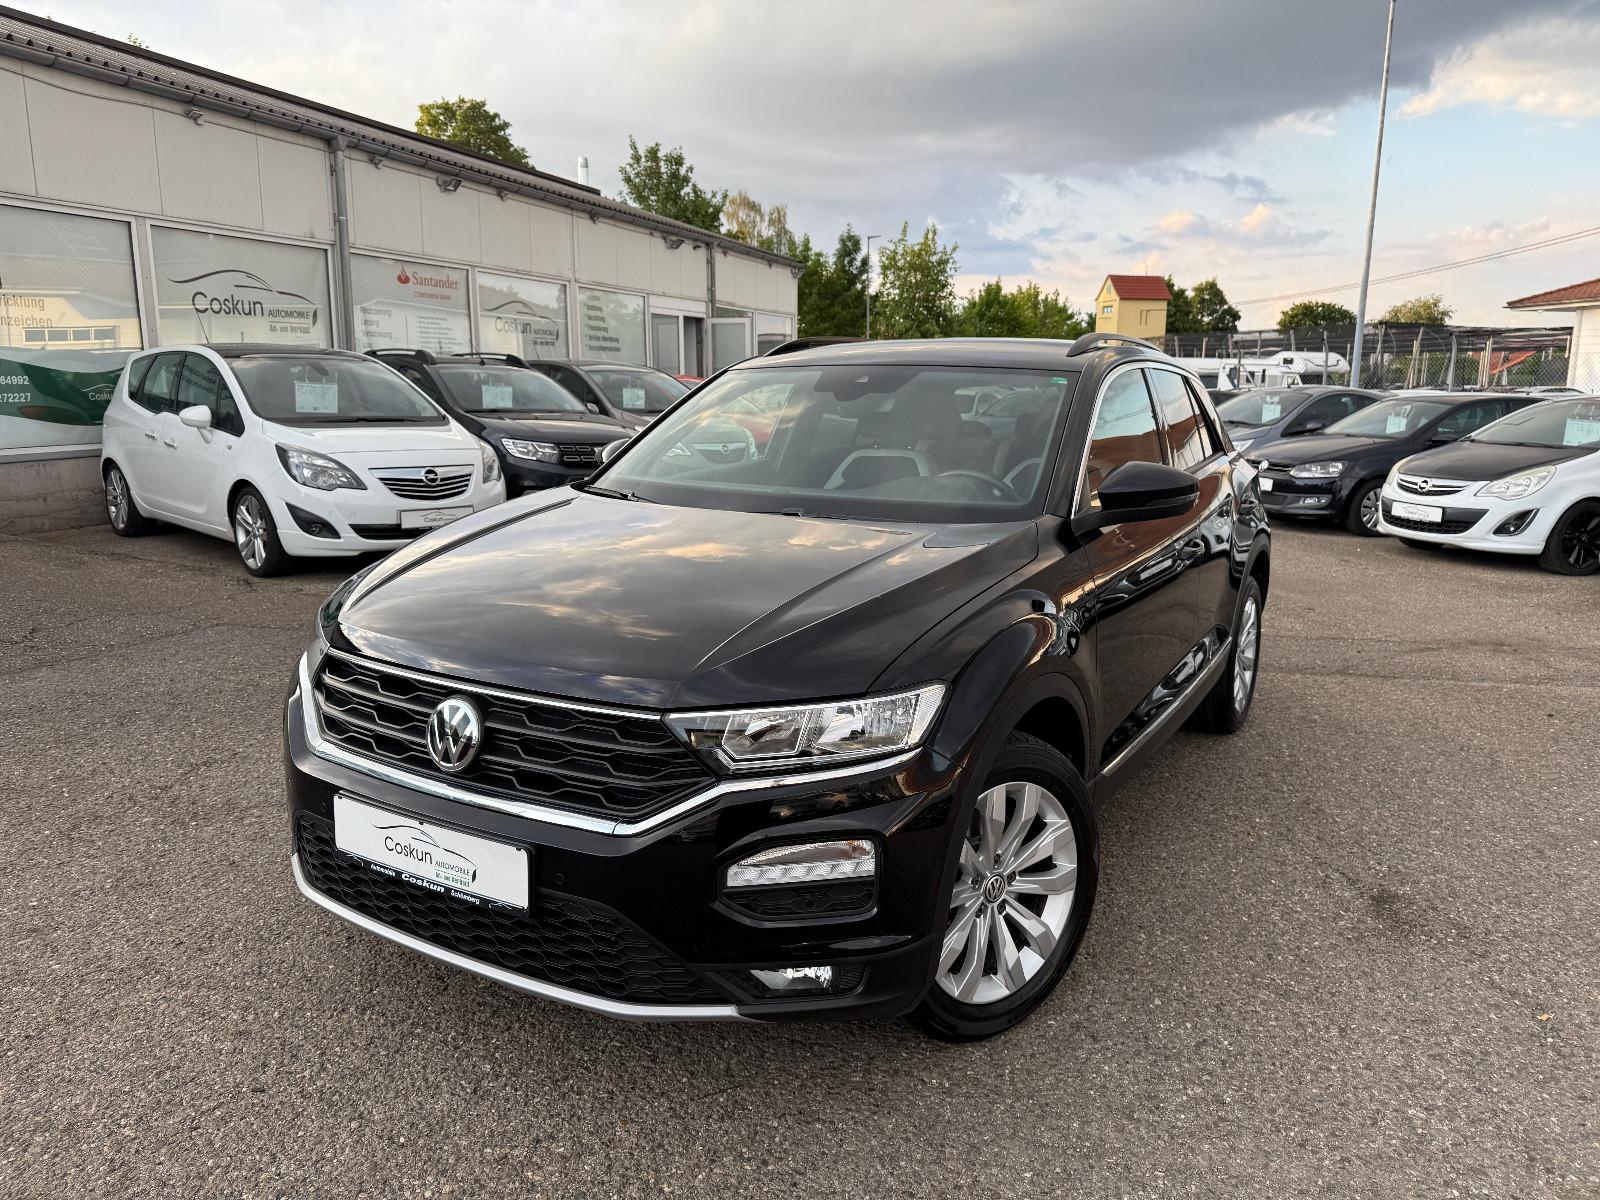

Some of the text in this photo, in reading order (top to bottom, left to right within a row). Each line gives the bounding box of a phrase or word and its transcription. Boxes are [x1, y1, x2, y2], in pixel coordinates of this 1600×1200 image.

[412, 271, 458, 290] Santander
[0, 295, 45, 311] icklung
[192, 291, 309, 320] Coskun AUTOMOBILE
[0, 314, 53, 328] nzeichen
[494, 316, 532, 335] Coskun
[384, 836, 433, 865] Coskun
[401, 873, 445, 893] Coskun
